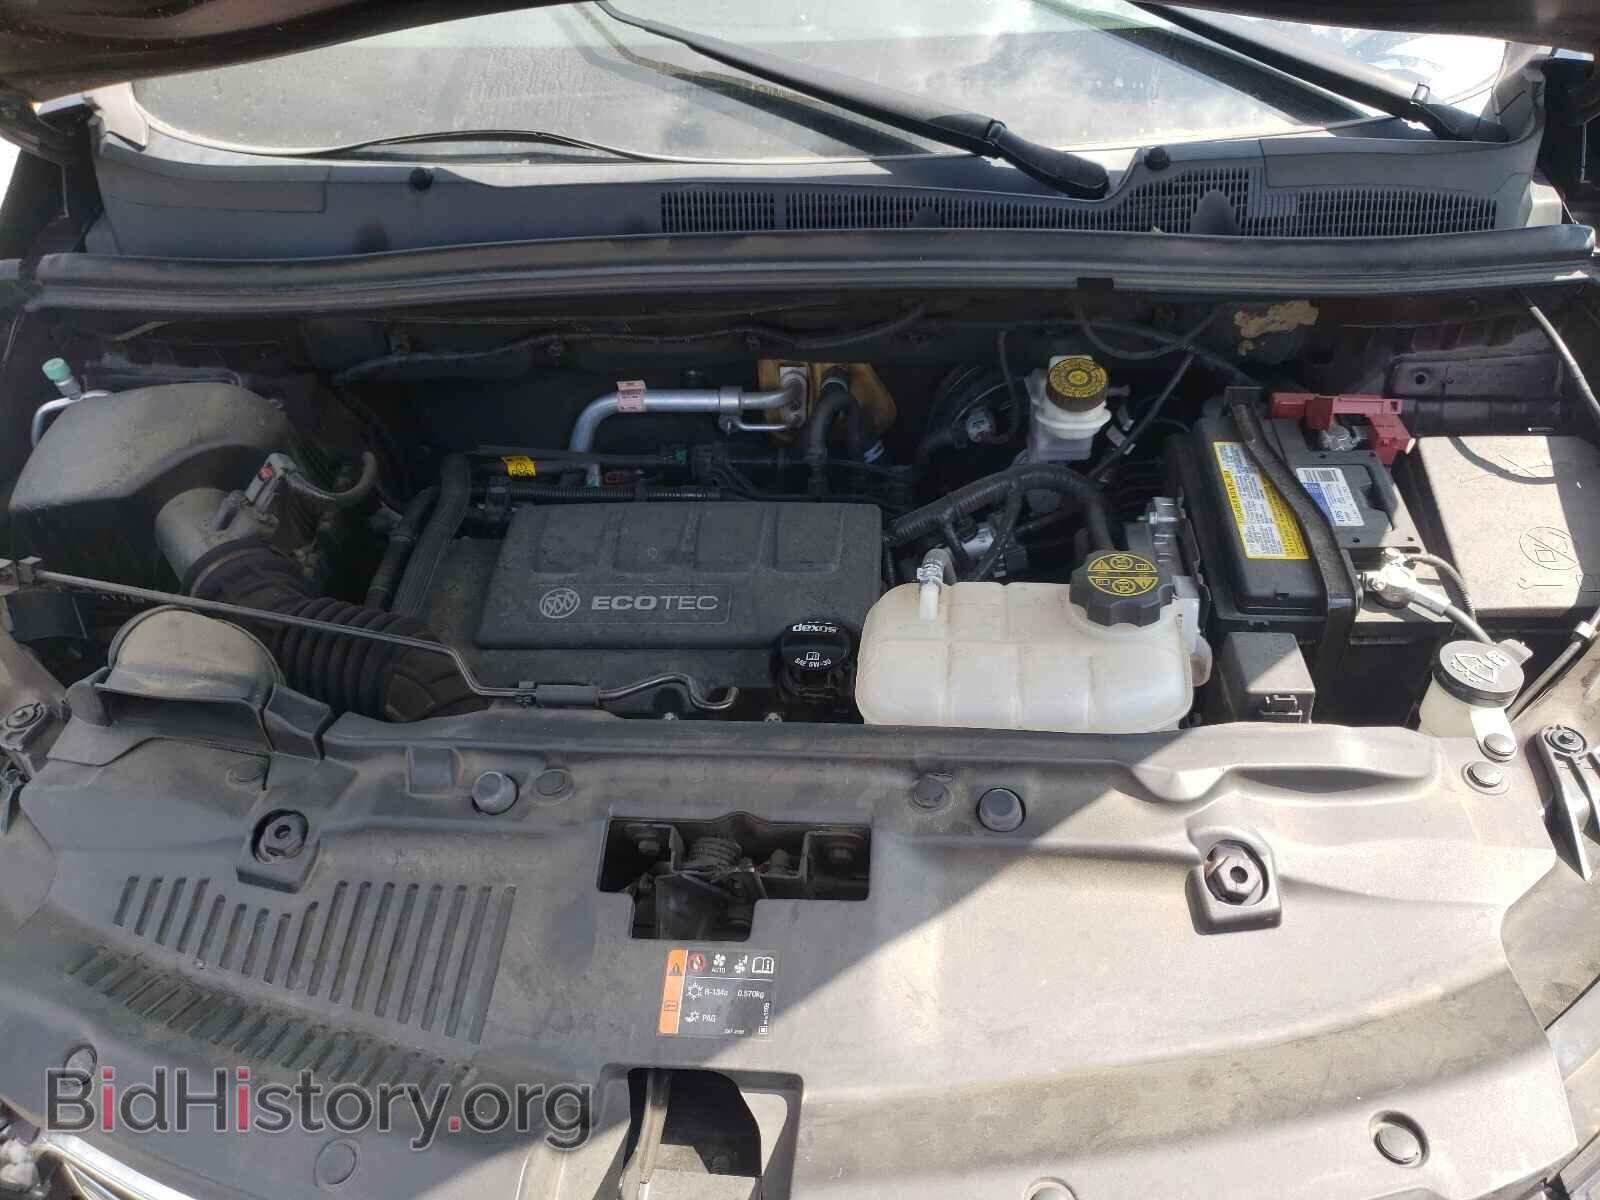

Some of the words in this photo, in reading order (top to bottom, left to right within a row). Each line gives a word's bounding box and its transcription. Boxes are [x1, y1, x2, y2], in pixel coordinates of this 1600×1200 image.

[591, 595, 719, 610] ECOTEC
[792, 623, 837, 633] dexos
[794, 657, 807, 667] SAE
[704, 988, 728, 996] R-134a
[737, 990, 765, 999] 0.570kg
[702, 1014, 716, 1022] PAG
